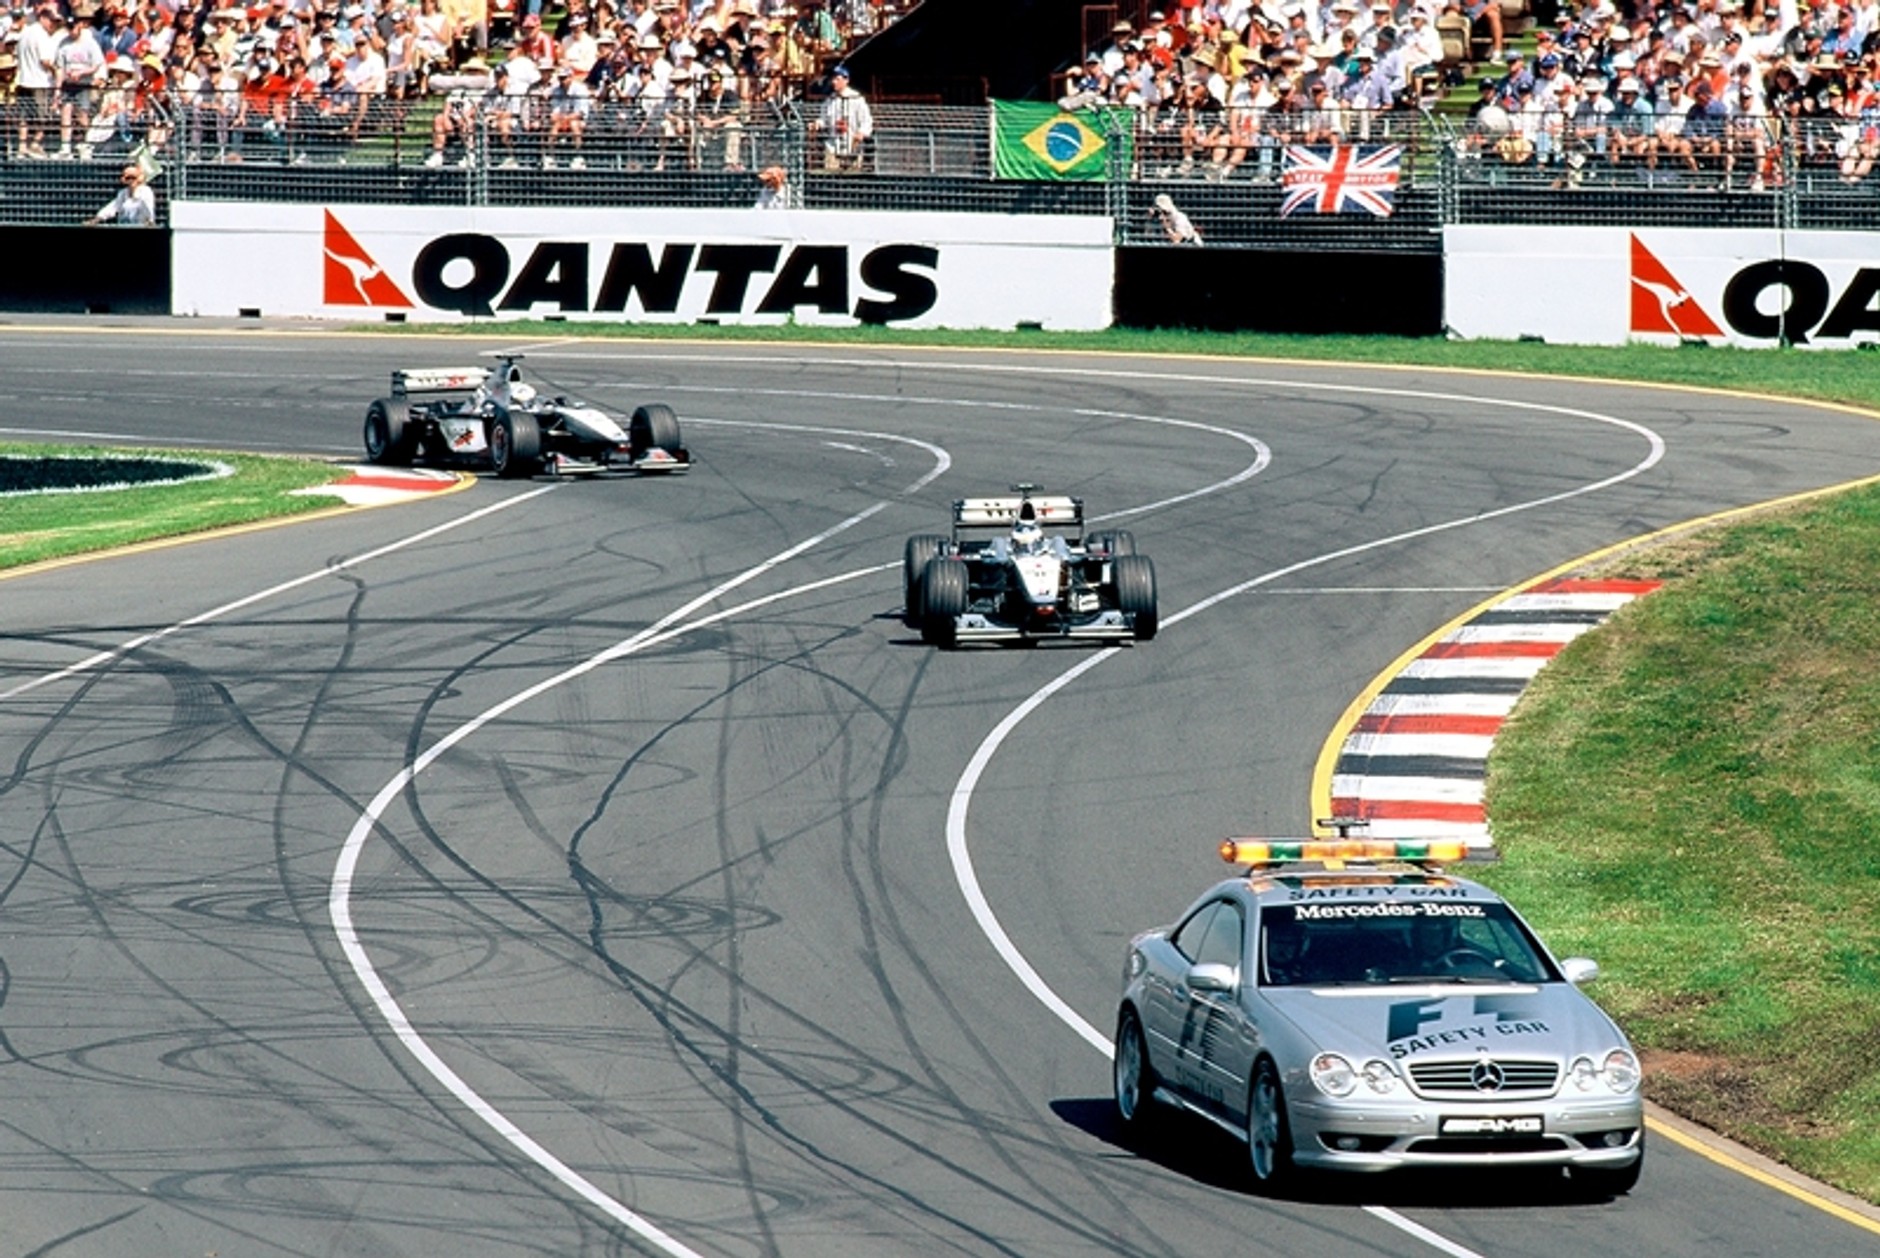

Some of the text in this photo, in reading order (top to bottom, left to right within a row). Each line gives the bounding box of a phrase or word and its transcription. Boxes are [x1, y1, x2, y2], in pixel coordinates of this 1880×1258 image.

[413, 233, 940, 322] QANTAS
[1289, 887, 1468, 900] SAFETY CAR
[1294, 902, 1487, 920] Mercedes-Benz
[1389, 1020, 1550, 1060] SAFETY CAR
[1476, 1118, 1542, 1133] AMG
